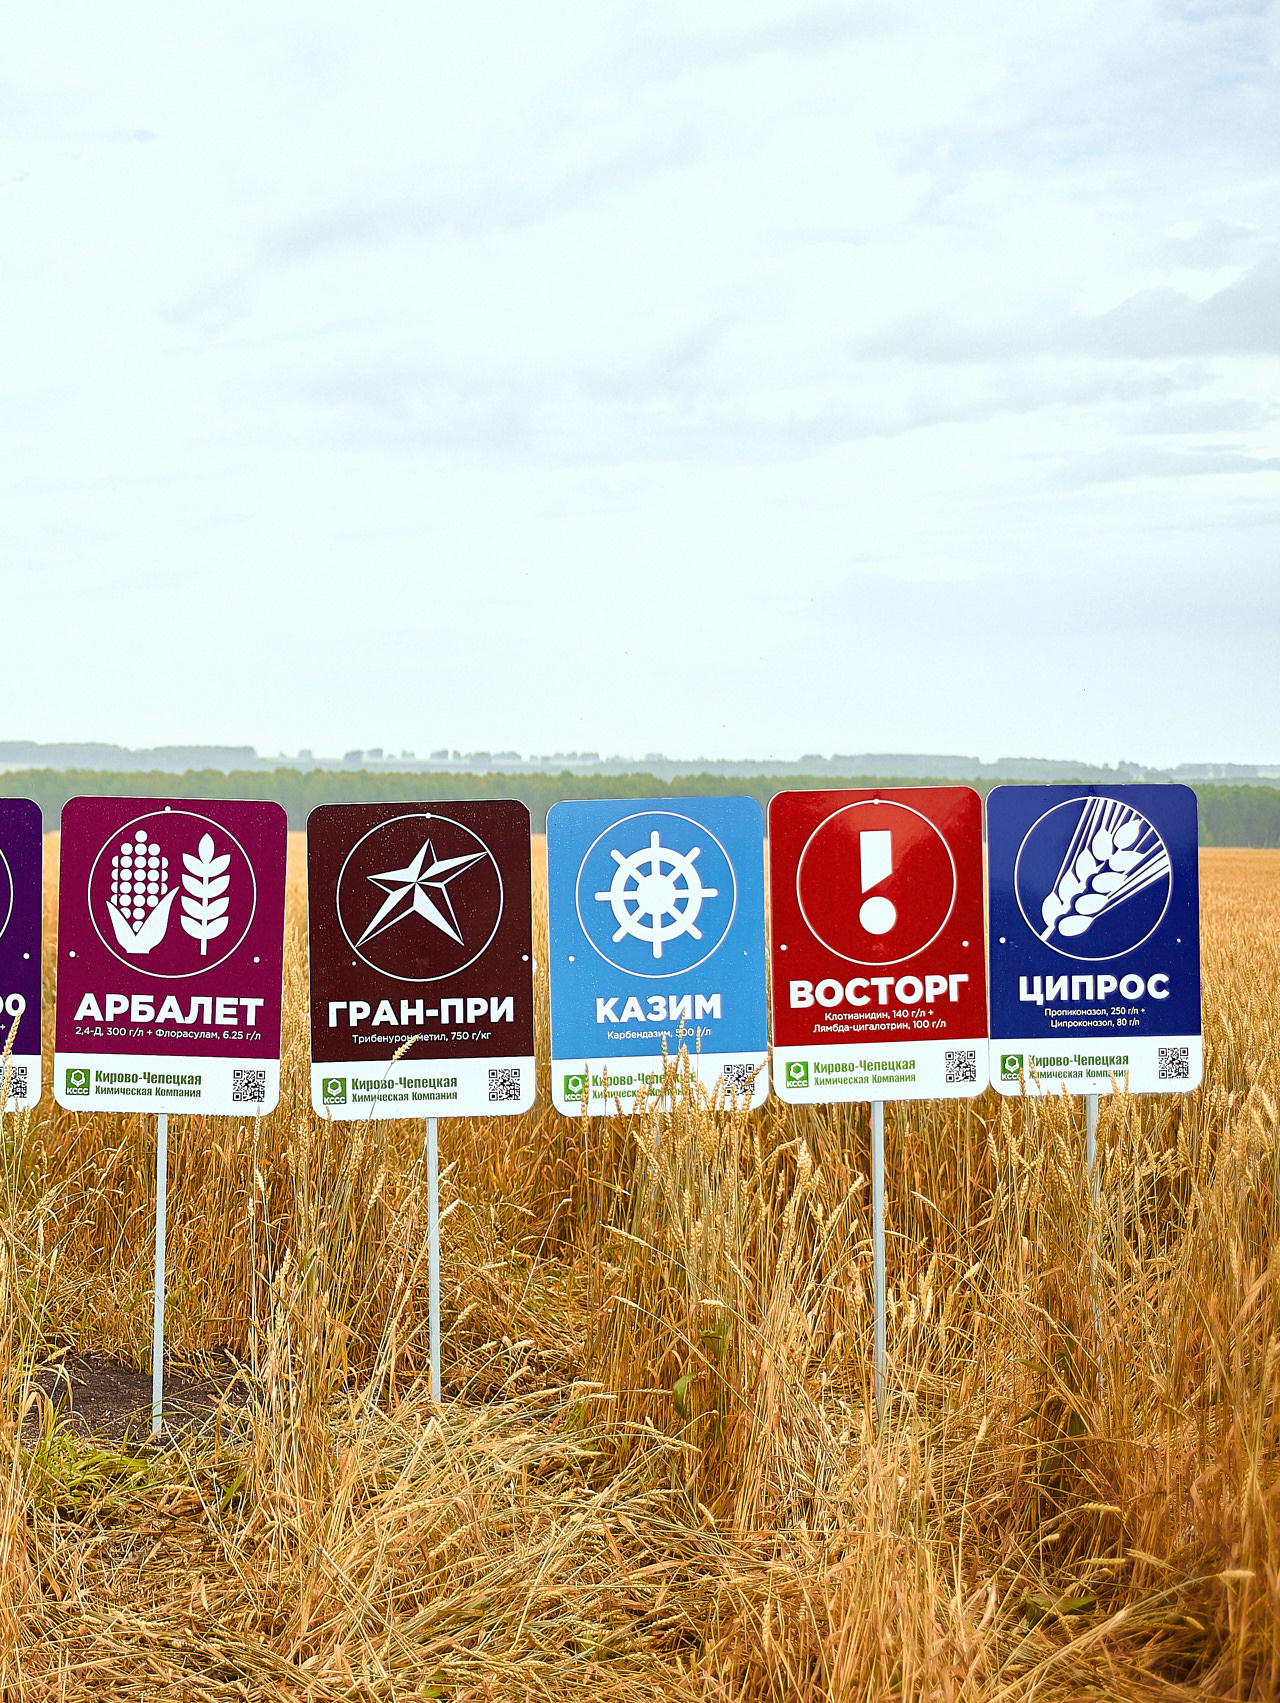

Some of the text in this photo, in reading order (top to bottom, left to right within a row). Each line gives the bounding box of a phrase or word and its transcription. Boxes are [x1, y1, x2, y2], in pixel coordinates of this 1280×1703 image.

[789, 973, 968, 1008] ВОСТОРГ
[1018, 972, 1169, 1006] ЦИПРОС
[73, 992, 264, 1025] АРБАЛЕТ
[328, 996, 514, 1027] ГРАН-ПРИ
[595, 993, 721, 1023] КАЗИМ
[824, 1011, 890, 1021] Клотианидин,
[891, 1008, 909, 1018] 140
[1044, 1007, 1108, 1018] Пропиконазол,
[1110, 1006, 1126, 1015] 250
[812, 1022, 910, 1032] Лямбда-цигалотрин,
[912, 1019, 930, 1028] 100
[1050, 1018, 1114, 1029] Ципроконазол,
[1116, 1017, 1127, 1026] 80
[74, 1025, 104, 1037] 2,4-Д,
[105, 1026, 126, 1036] 300
[154, 1028, 220, 1039] Флорасулам,
[222, 1030, 243, 1039] 6.25
[351, 1030, 492, 1045] Трибенуронметил, 750 г/кг
[607, 1029, 673, 1041] Карбендазим,
[675, 1028, 695, 1037] 500
[813, 1059, 915, 1075] Кирово-Чепецкая
[95, 1070, 201, 1086] Кирово-Чепецкая
[351, 1076, 457, 1092] Кирово-Чепецкая
[813, 1073, 915, 1085] Химическая Компания
[94, 1084, 201, 1097] Химическая Компания
[351, 1091, 457, 1102] Химическая Компания
[565, 1093, 585, 1101] KCC
